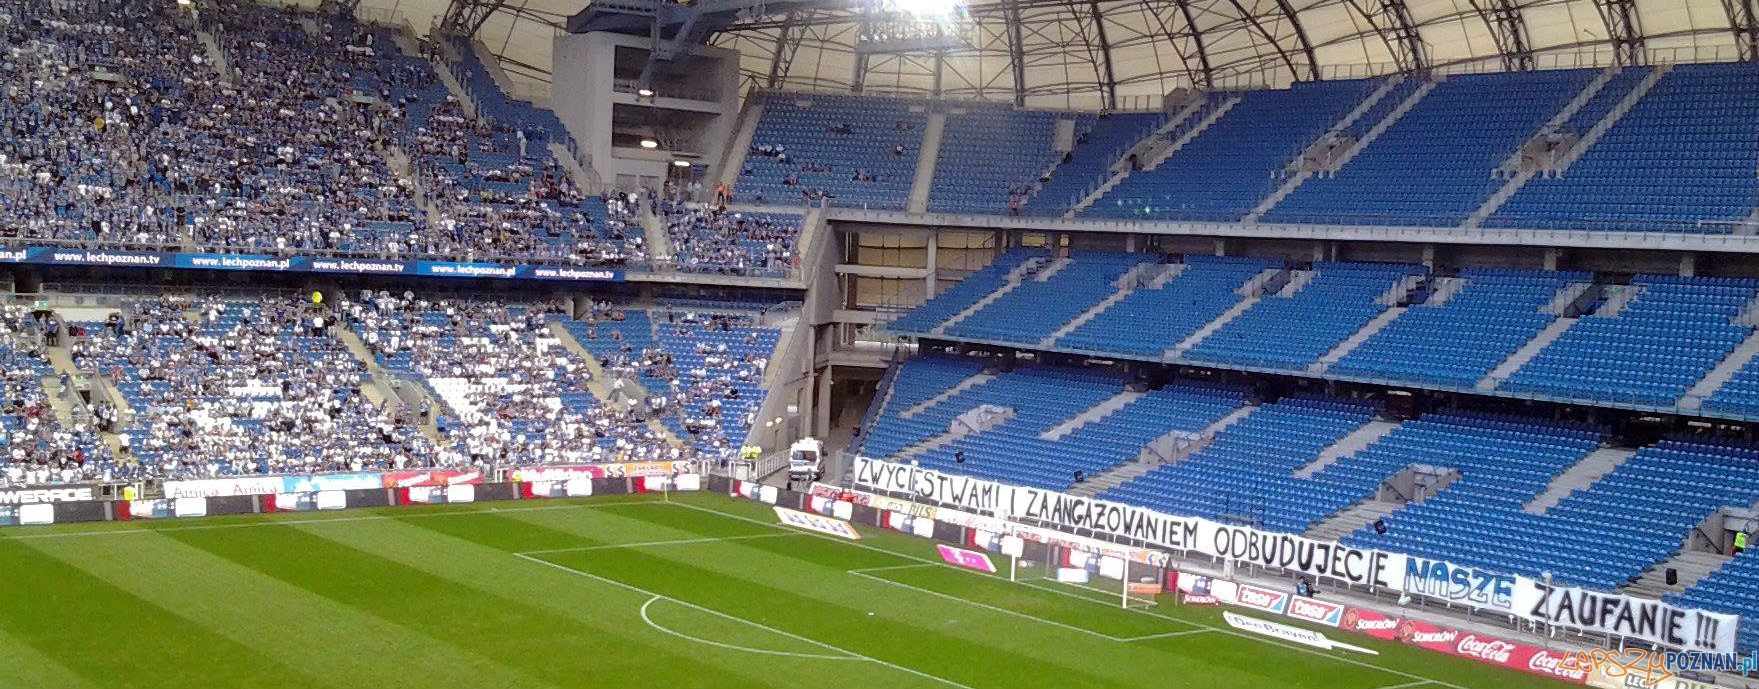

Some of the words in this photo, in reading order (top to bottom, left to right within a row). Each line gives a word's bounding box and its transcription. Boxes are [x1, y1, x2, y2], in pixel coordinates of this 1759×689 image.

[1010, 488, 1016, 516] I
[1213, 526, 1389, 588] ODBUDUJECIE
[1402, 556, 1517, 609] NASZE
[1529, 582, 1687, 648] ZAUFANIE
